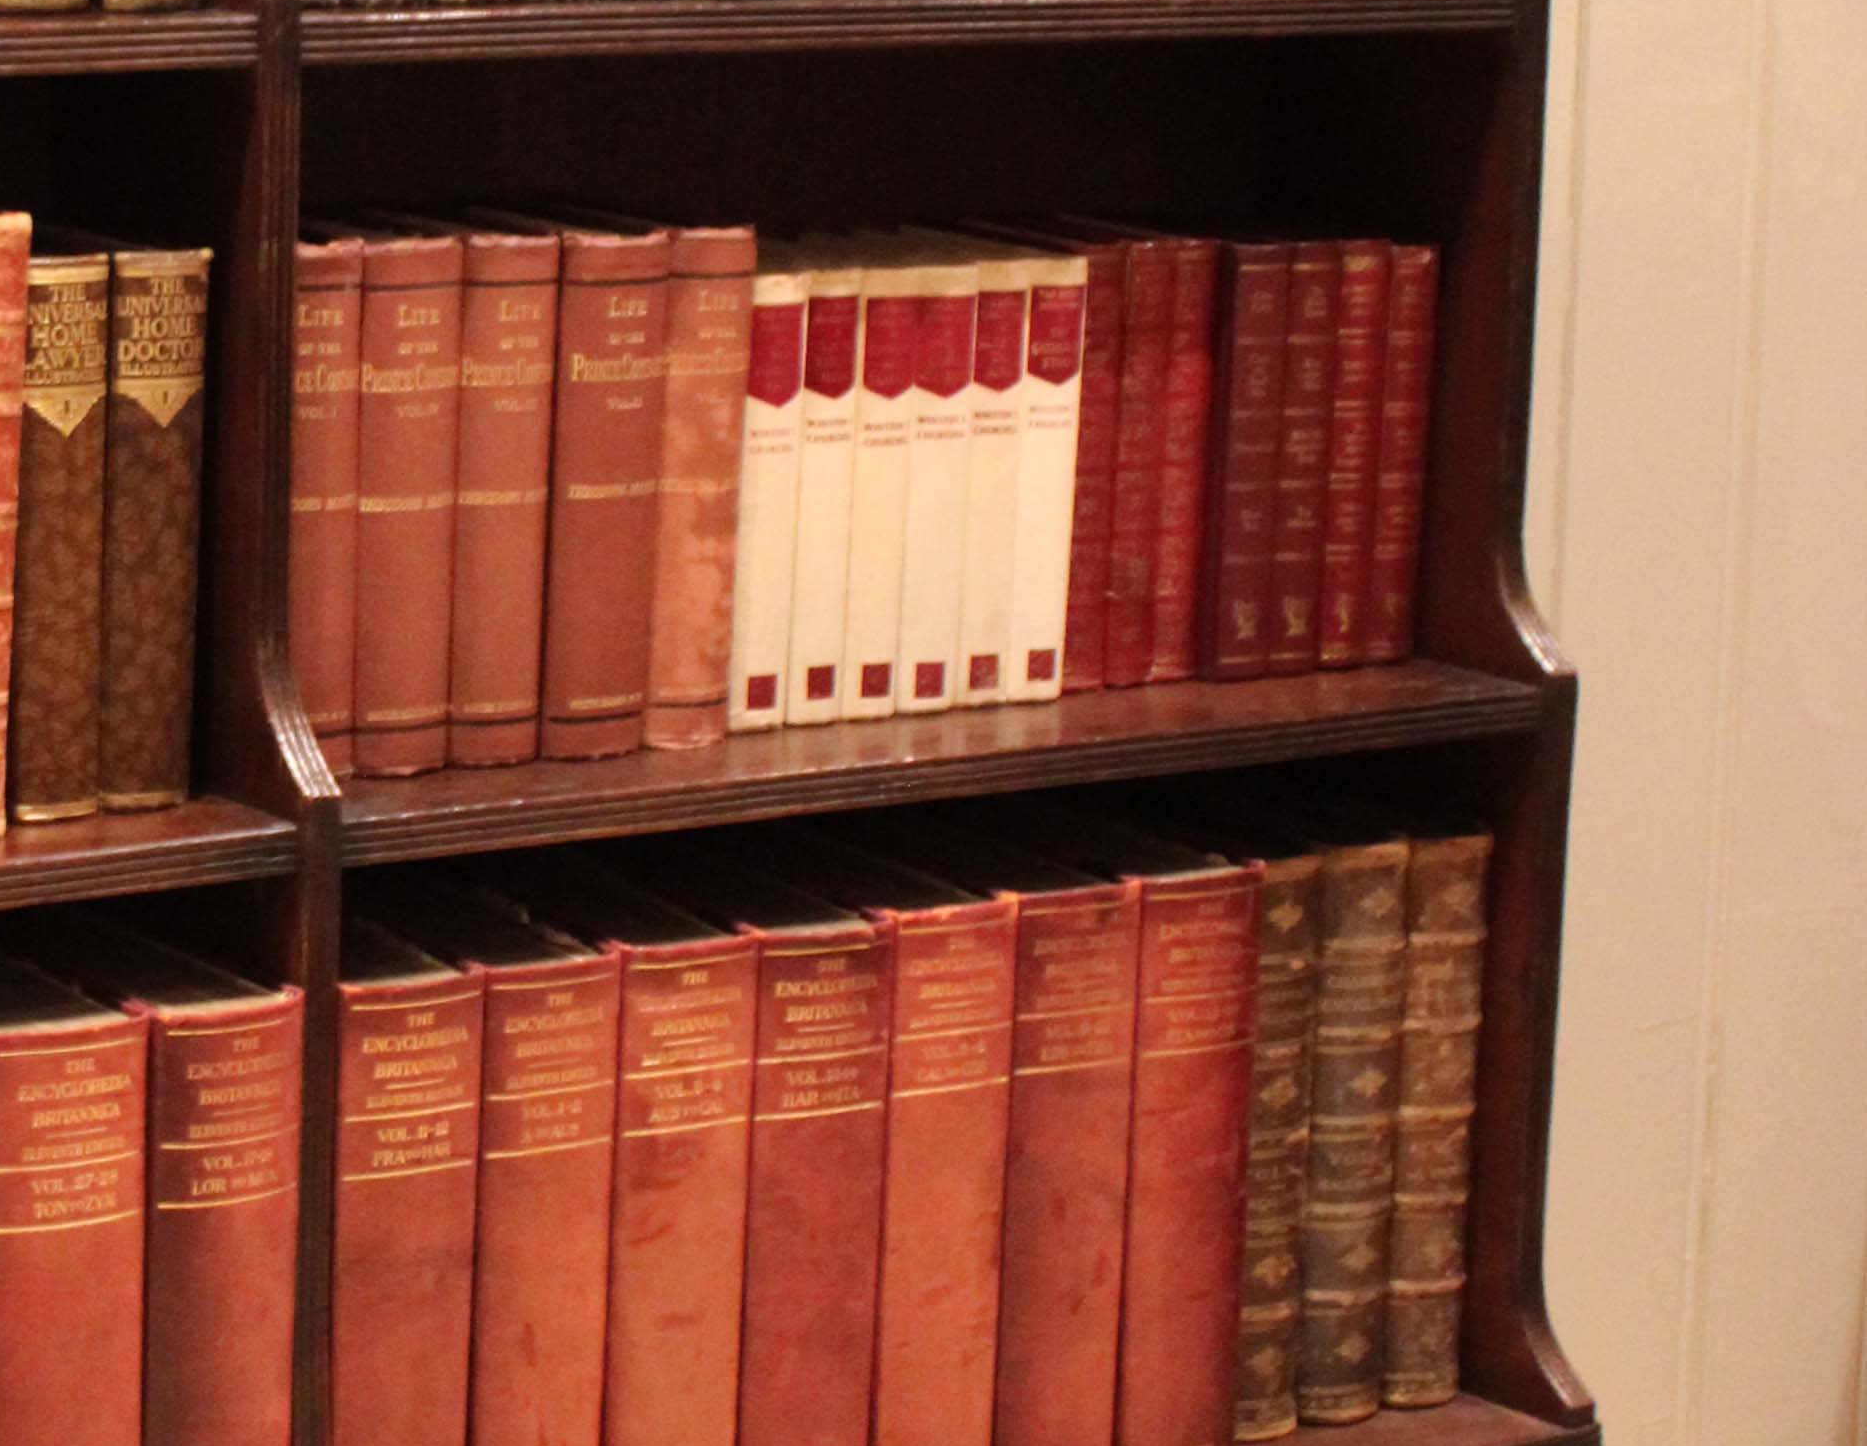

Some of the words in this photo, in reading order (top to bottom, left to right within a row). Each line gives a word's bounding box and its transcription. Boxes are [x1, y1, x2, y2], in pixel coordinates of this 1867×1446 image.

[49, 284, 86, 303] THE
[151, 278, 184, 295] THE
[398, 305, 440, 328] LIFE
[498, 301, 541, 321] LIFE
[608, 296, 648, 318] LIFE
[32, 324, 97, 349] HOME
[132, 316, 196, 340] HOME
[362, 364, 415, 393] PRINCE
[407, 1012, 436, 1028] THE
[65, 1058, 96, 1074] THE
[191, 1178, 227, 1197] LOR
